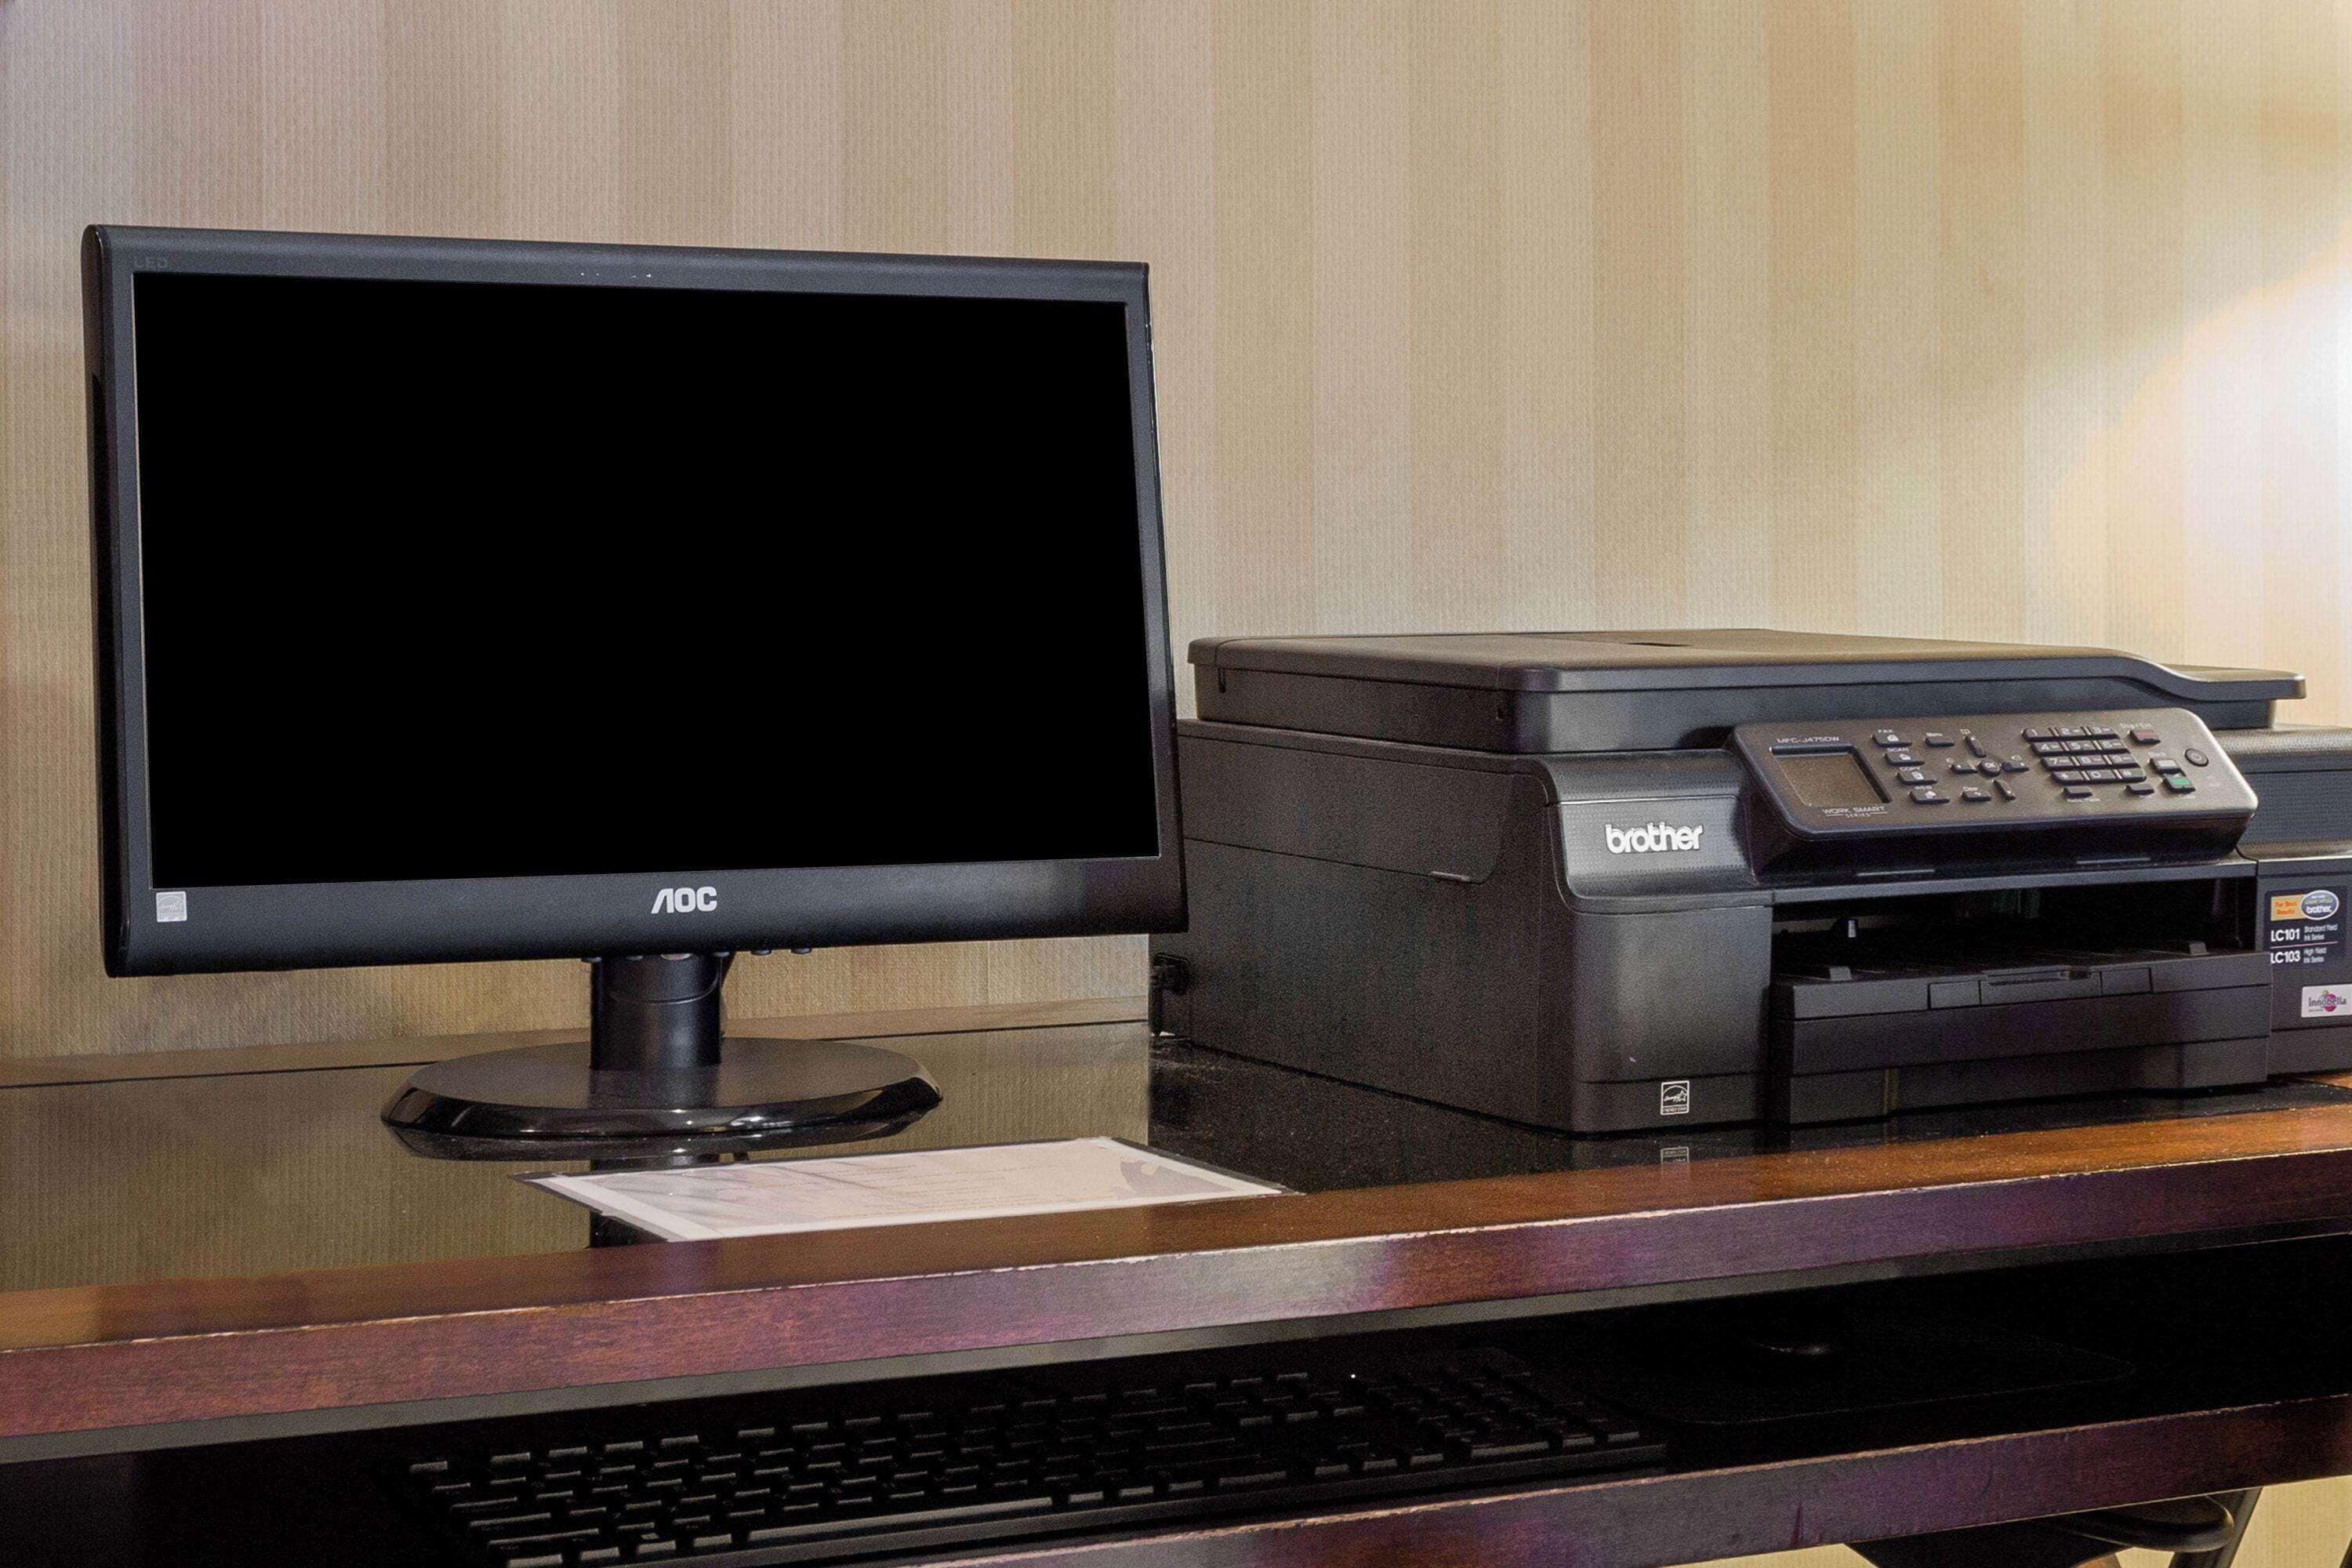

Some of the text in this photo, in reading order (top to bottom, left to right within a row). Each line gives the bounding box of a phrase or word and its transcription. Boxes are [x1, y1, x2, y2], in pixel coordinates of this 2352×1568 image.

[1604, 822, 1704, 854] brother
[651, 886, 717, 914] AOC
[2270, 928, 2300, 942] LC101
[2270, 949, 2301, 964] LC103
